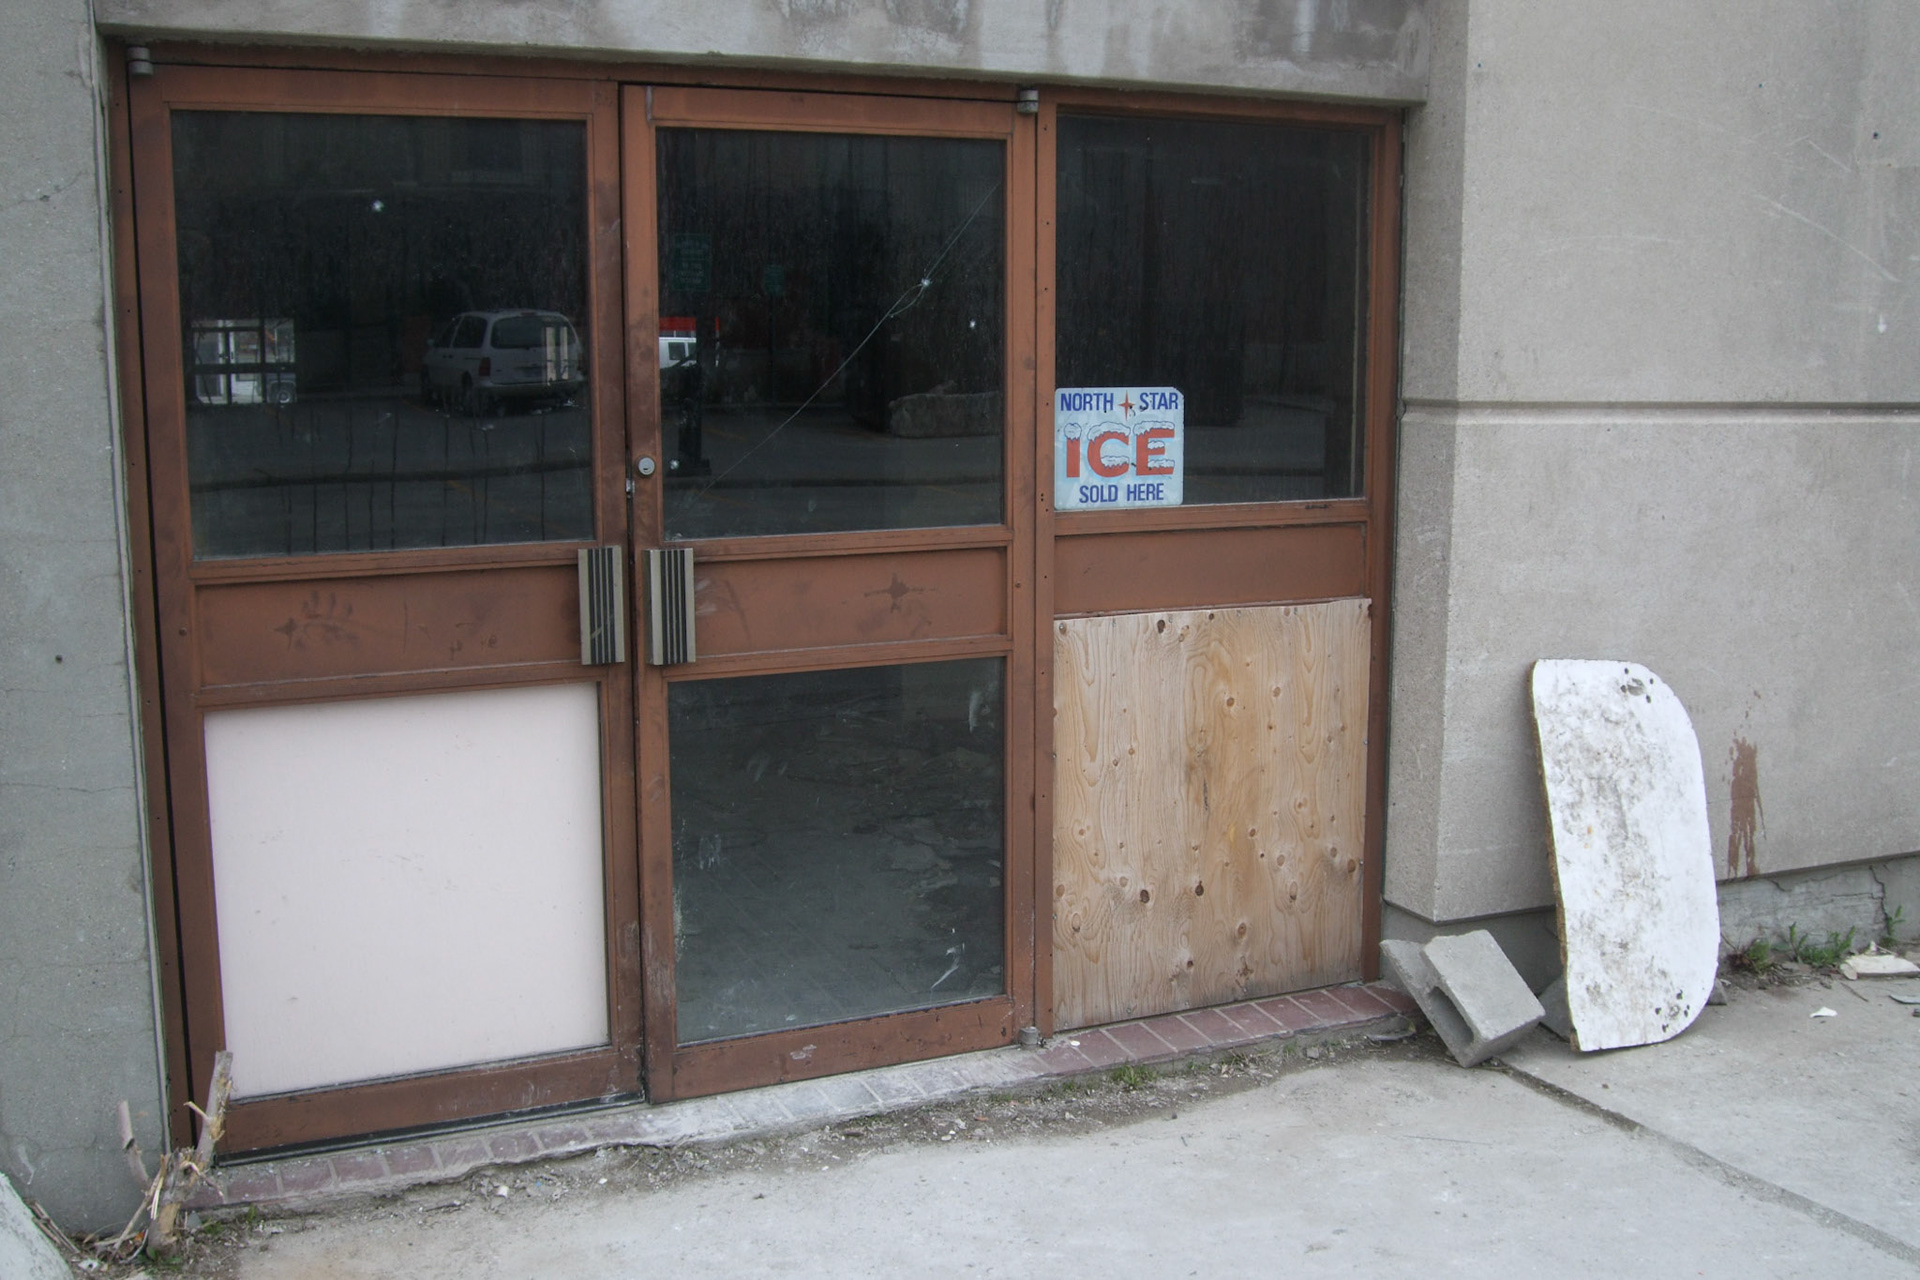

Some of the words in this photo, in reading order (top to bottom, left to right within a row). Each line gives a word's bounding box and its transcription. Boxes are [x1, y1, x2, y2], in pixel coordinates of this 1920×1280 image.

[1060, 392, 1114, 412] NORTH
[1139, 392, 1179, 410] STAR
[1064, 421, 1175, 478] ICE
[1079, 484, 1119, 504] SOLD
[1127, 483, 1164, 502] HERE
